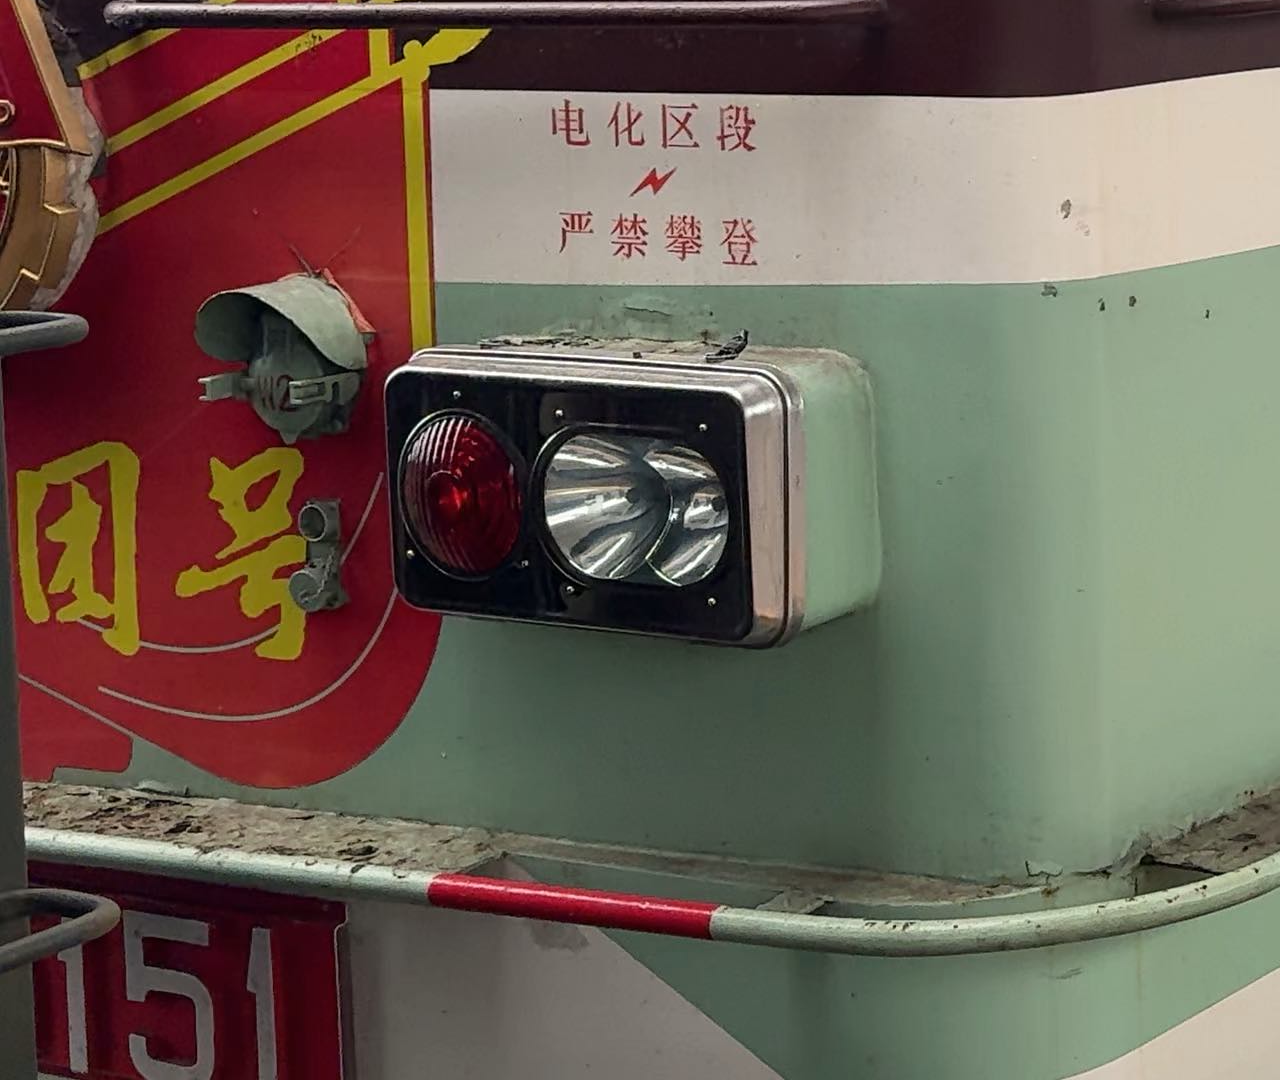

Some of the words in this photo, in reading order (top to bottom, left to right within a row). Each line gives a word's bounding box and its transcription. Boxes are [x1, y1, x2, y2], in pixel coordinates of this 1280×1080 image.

[551, 99, 757, 152] 电化区段
[559, 211, 758, 266] 严禁攀登
